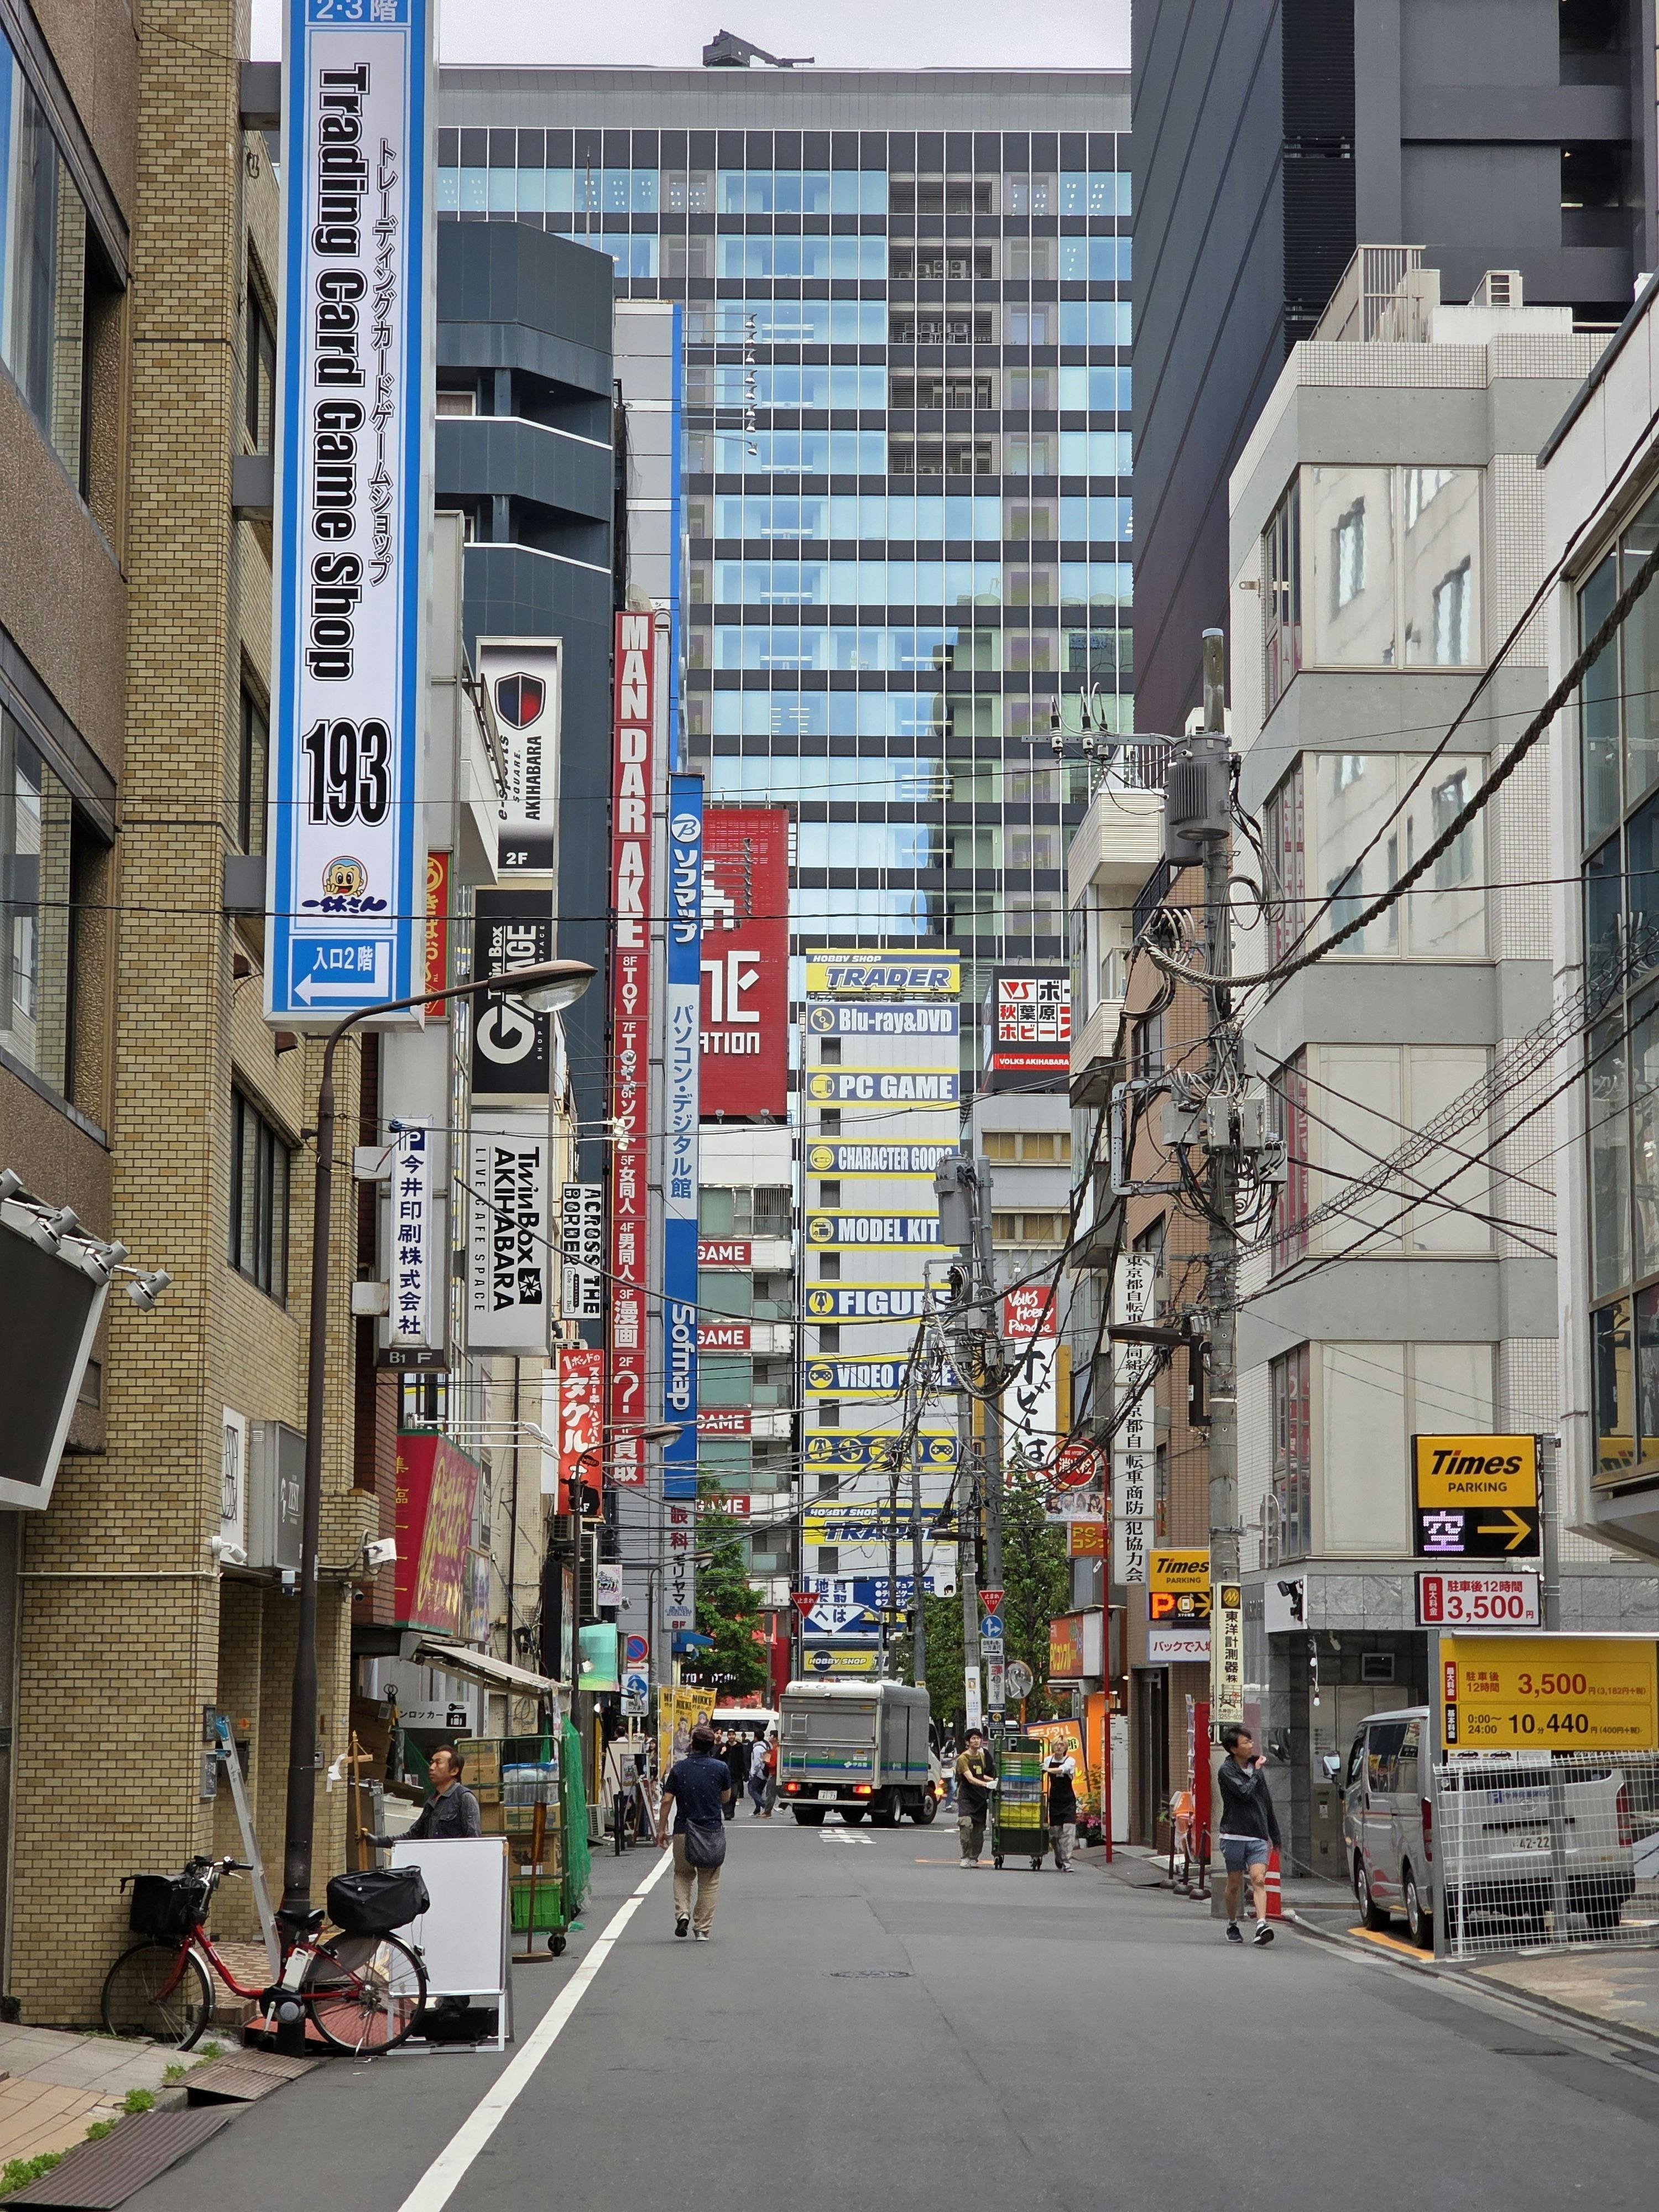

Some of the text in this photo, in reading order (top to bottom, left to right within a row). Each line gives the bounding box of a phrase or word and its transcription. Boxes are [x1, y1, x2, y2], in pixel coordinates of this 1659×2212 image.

[305, 62, 370, 681] Trading Card Game Shop
[368, 138, 398, 587] トレーディングカードゲームショップ
[302, 717, 392, 827] 193
[525, 736, 541, 820] AKIHABARA
[617, 616, 648, 948] MANDARAKE
[506, 852, 528, 865] 2F
[674, 849, 698, 943] ソフマップ
[312, 946, 373, 972] 入口2階
[623, 957, 638, 966] 8F
[622, 967, 638, 1015] TOY
[826, 967, 952, 989] TRADER
[839, 1008, 952, 1035] Blu-ray&DVD
[1000, 1004, 1056, 1021] 秋葉原
[623, 1022, 637, 1032] 7F
[1000, 1024, 1056, 1040] ホビー
[839, 1075, 952, 1099] PC GAME
[671, 1005, 694, 1200] パソコン・デジタル館
[620, 1156, 635, 1165] 5F
[838, 1147, 909, 1171] CHARACTER
[618, 1167, 636, 1214] 女同人
[474, 1148, 487, 1311] LIVE CAFE SPACE
[493, 1147, 515, 1312] AKIHABARA
[564, 1188, 581, 1265] BORDER
[620, 1222, 634, 1232] 4F
[838, 1219, 940, 1242] MODEL KIT
[397, 1154, 424, 1335] 今井印刷株式会社
[583, 1188, 601, 1313] ACROSS THE
[618, 1233, 635, 1282] 男同人
[619, 1289, 634, 1298] 3F
[613, 1300, 639, 1348] 漫画
[1008, 1319, 1053, 1334] Paradse
[619, 1357, 634, 1366] 2F
[667, 1304, 695, 1410] Sofmap
[837, 1364, 894, 1388] VIDEO
[561, 1372, 590, 1454] タケル
[614, 1435, 638, 1481] 買取
[1431, 1450, 1523, 1475] Times
[1448, 1481, 1507, 1493] PARKING
[670, 1506, 688, 1550] 眼科
[1073, 1527, 1095, 1537] PC
[1423, 1511, 1465, 1552] 空
[1156, 1558, 1209, 1573] Times
[672, 1554, 686, 1605] モリヤマ
[1447, 1580, 1523, 1593] 駐車後12時間
[1152, 1593, 1175, 1619] P
[1428, 1583, 1438, 1616] 最大料金
[809, 1657, 839, 1666] HOBBY
[1466, 1671, 1500, 1681] 駐車後
[1467, 1682, 1500, 1693] 12時間
[1468, 1725, 1498, 1734] 24:00
